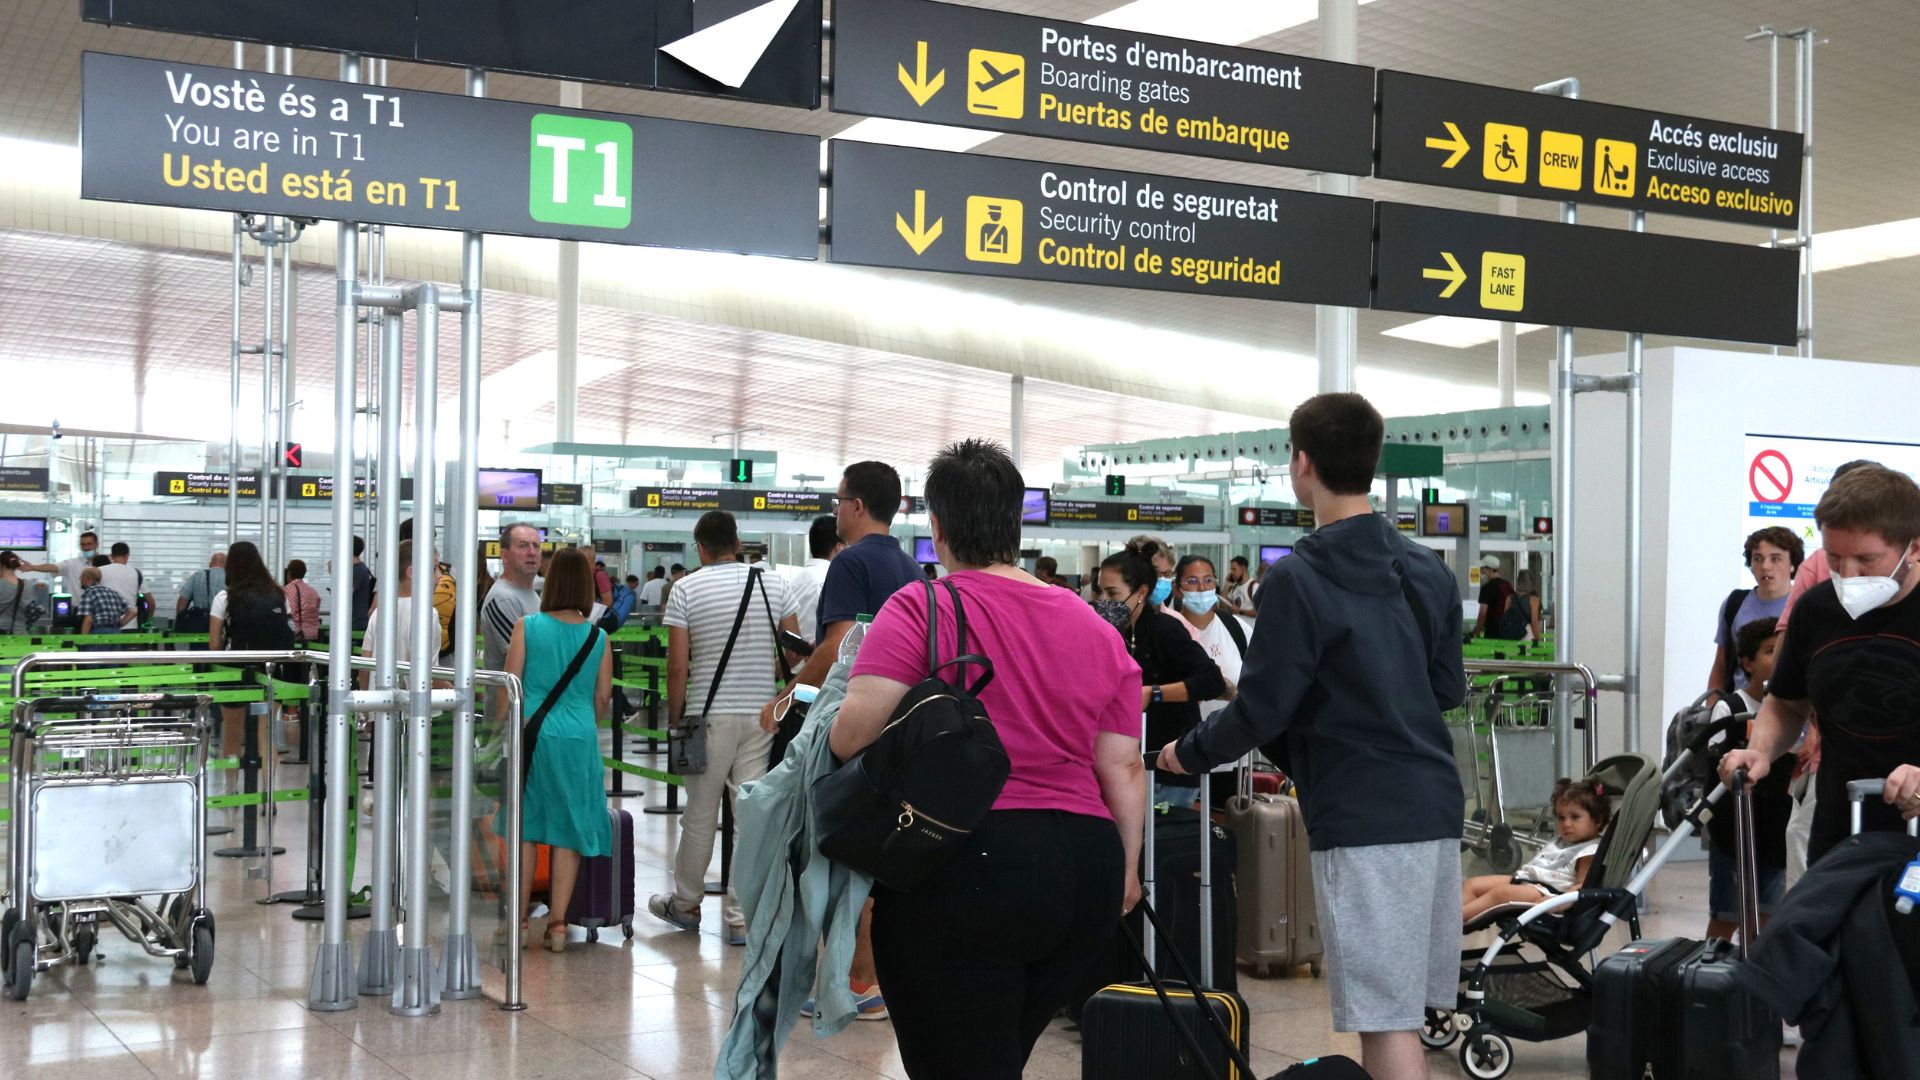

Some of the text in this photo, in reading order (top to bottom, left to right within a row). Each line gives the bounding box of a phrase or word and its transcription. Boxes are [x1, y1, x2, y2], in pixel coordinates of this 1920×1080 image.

[1042, 28, 1302, 90] Portes d'embarcament
[165, 71, 404, 128] Vostè és a T1
[1041, 62, 1190, 104] Boarding gates
[165, 114, 365, 161] You are in T1
[1040, 93, 1290, 152] Puertas de embarque
[1649, 119, 1778, 159] Accés exclusiu
[536, 134, 626, 208] T1
[1543, 151, 1579, 170] CREW
[1647, 149, 1770, 184] Exclusive access
[163, 153, 460, 211] Usted está en T1
[1040, 172, 1278, 222] Control de seguretat
[1646, 176, 1793, 217] Acceso exclusivo
[1040, 207, 1196, 243] Security control
[1038, 238, 1281, 286] Control de seguridad
[1491, 266, 1516, 279] FAST
[1490, 283, 1515, 297] LANE
[662, 488, 682, 496] Control
